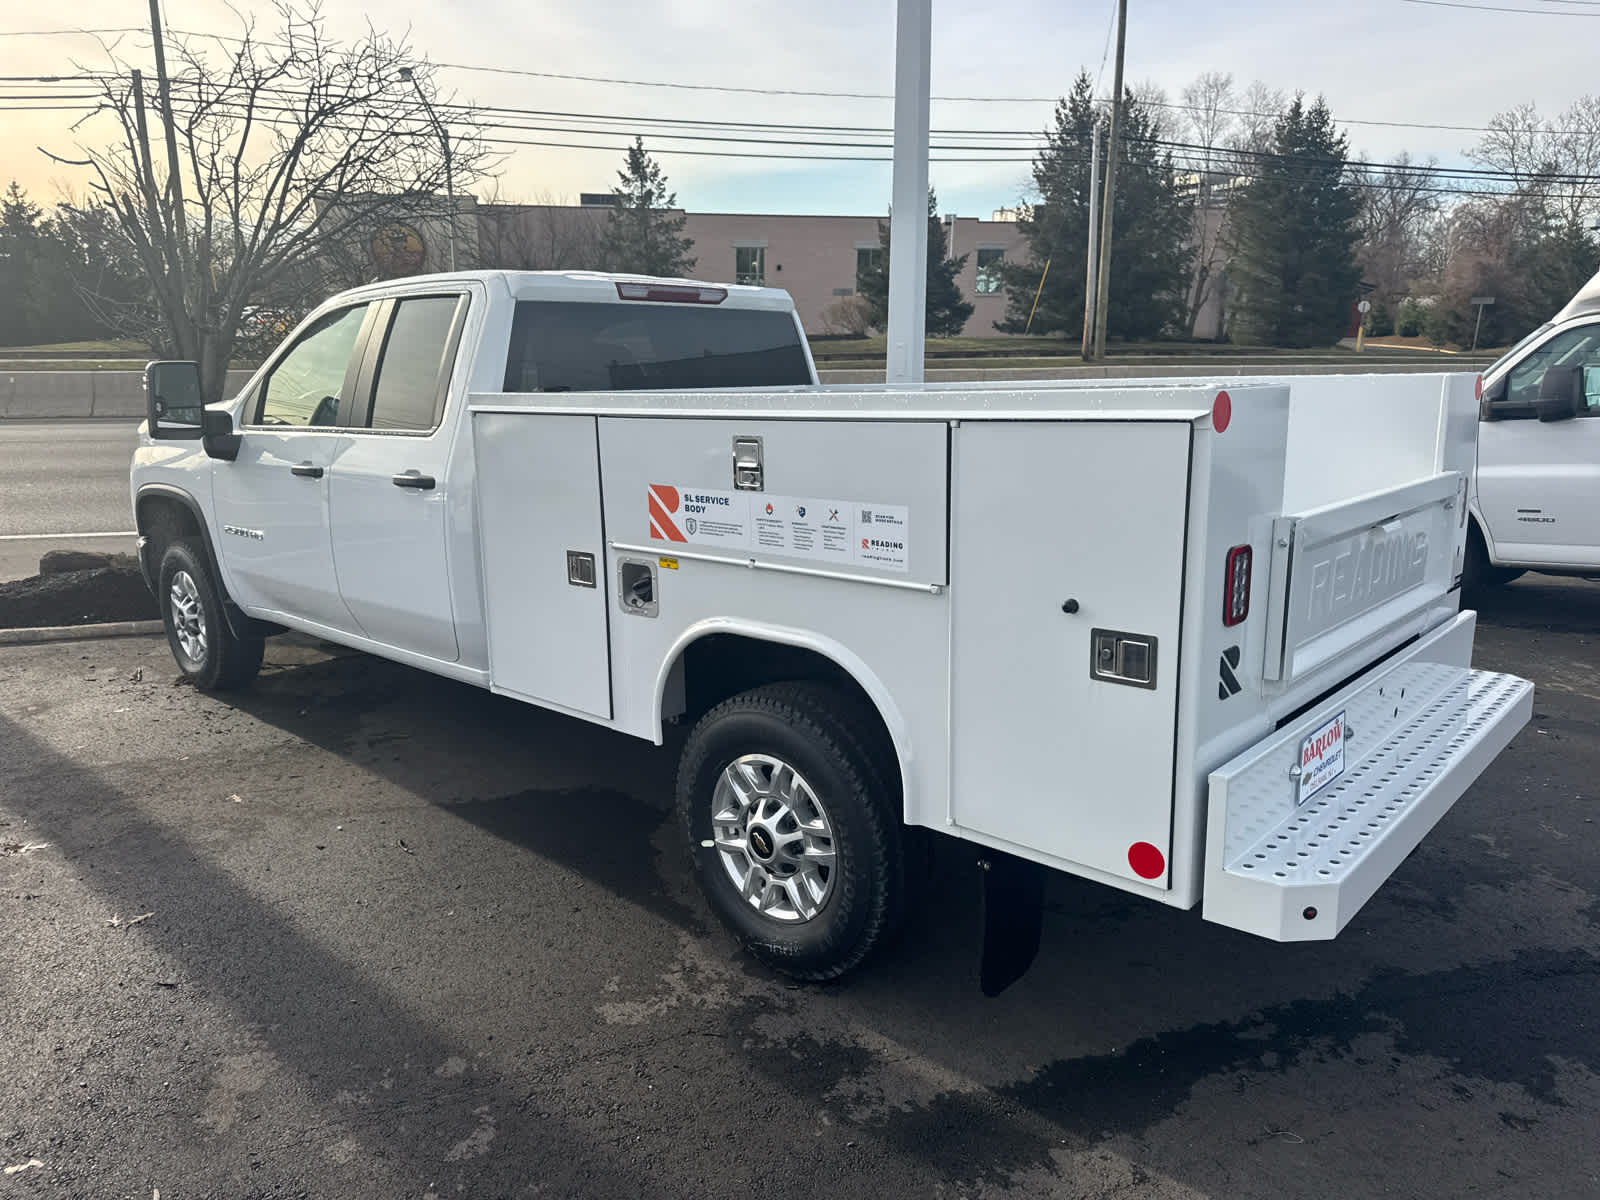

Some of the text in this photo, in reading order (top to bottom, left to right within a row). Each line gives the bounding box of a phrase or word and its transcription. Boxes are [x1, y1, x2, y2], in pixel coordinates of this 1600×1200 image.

[684, 494, 730, 506] SL SERVICE
[685, 504, 706, 514] BODY
[871, 539, 903, 550] READING
[1303, 722, 1342, 766] BARLOW
